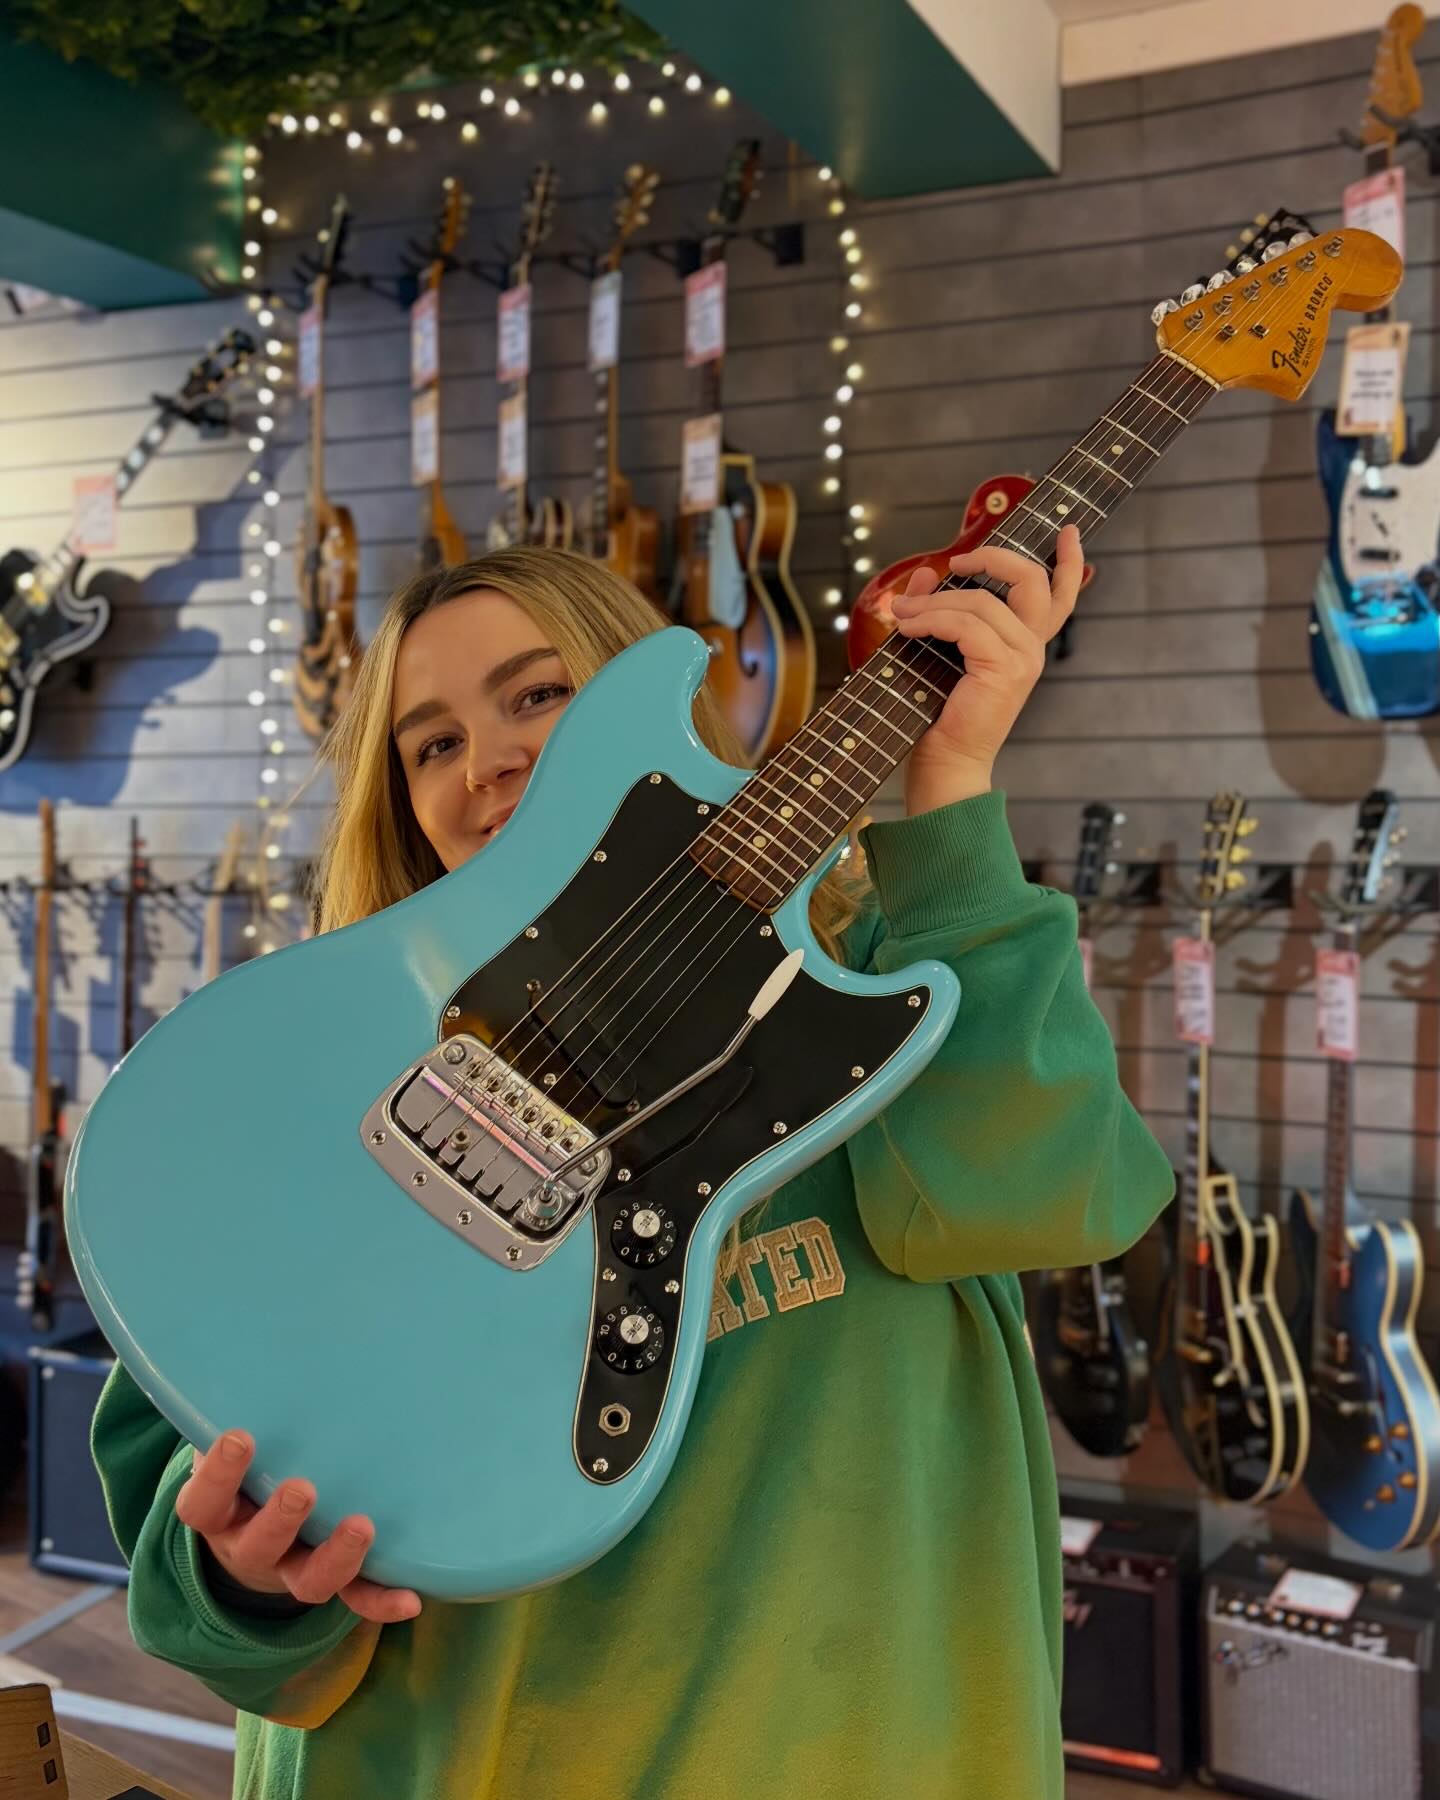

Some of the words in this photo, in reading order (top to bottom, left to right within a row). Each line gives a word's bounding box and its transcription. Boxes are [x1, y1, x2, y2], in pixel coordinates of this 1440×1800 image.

[1272, 326, 1311, 377] Fender
[1305, 275, 1333, 320] BRONCO
[632, 1202, 640, 1210] 8
[620, 1209, 628, 1218] 9
[613, 1220, 623, 1230] 10
[621, 1246, 630, 1256] 0
[658, 1246, 668, 1255] 3
[647, 1253, 655, 1263] 2
[620, 1305, 628, 1315] 8
[607, 1313, 616, 1322] 9
[646, 1313, 655, 1322] 6
[600, 1324, 610, 1336] 10
[653, 1326, 663, 1334] 5
[607, 1352, 617, 1362] 0
[646, 1352, 656, 1362] 3
[635, 1359, 644, 1369] 2
